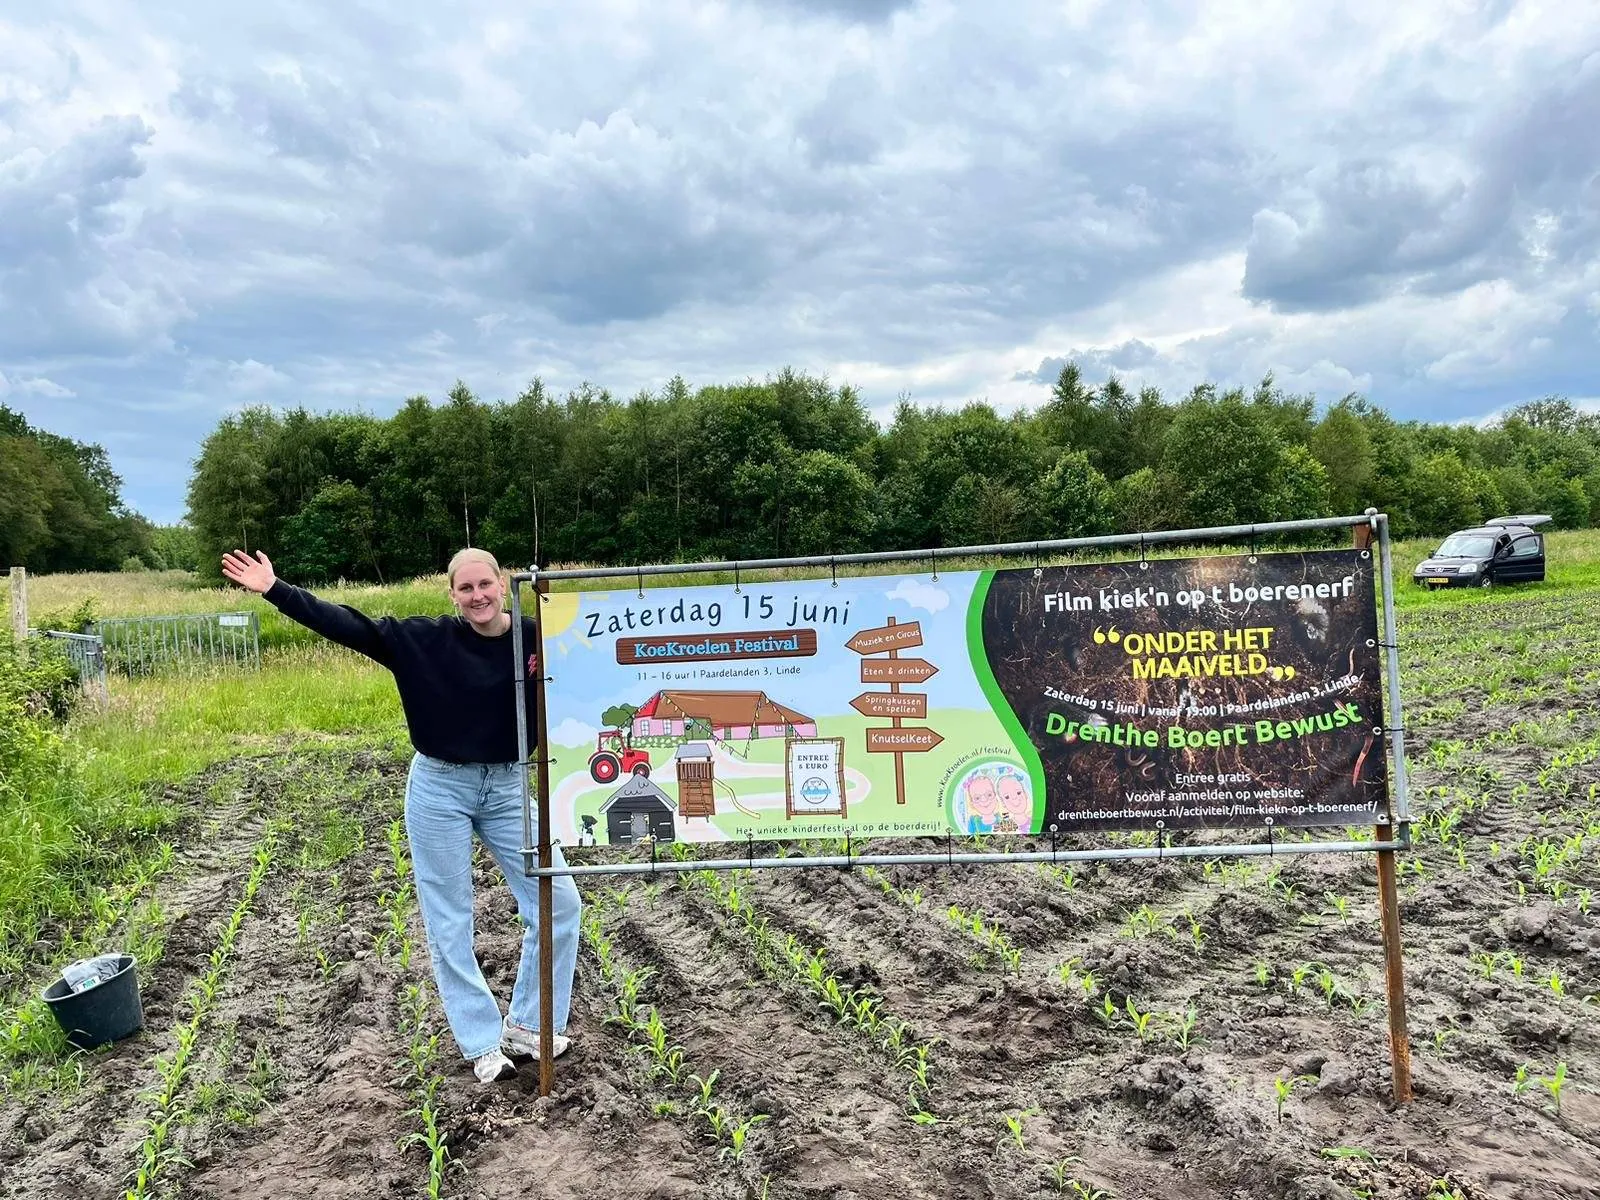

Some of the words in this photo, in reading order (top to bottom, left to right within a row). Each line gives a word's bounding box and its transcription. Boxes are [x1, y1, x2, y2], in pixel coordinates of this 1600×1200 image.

[1043, 592, 1093, 613] Film
[1099, 587, 1170, 611] kiek'n
[1175, 590, 1206, 609] op
[1229, 576, 1354, 603] boerenerf
[585, 598, 722, 638] Zaterdag
[742, 594, 773, 620] 15
[786, 595, 851, 627] juni
[633, 639, 731, 659] KoeKroelen
[734, 635, 799, 653] Festival
[855, 636, 884, 649] Muziek
[885, 634, 895, 642] en
[896, 630, 920, 639] Circus
[1223, 627, 1274, 651] HET
[637, 672, 647, 681] 11
[661, 671, 672, 680] 16
[674, 672, 690, 680] uur
[700, 667, 760, 679] Paardelanden
[776, 665, 801, 675] Linde
[863, 667, 884, 675] Eten
[887, 666, 893, 675] &
[898, 666, 931, 675] drinken
[865, 695, 921, 706] Springkussen
[1043, 685, 1097, 710] Zaterdag
[1100, 700, 1114, 711] 15
[1114, 701, 1139, 714] juni
[1148, 704, 1182, 717] vanaf
[1185, 705, 1217, 717] 19:00
[1226, 691, 1311, 714] Paardelanden
[1310, 686, 1325, 697] 3,
[1324, 674, 1359, 693] Linde
[886, 705, 917, 713] spellen
[1045, 712, 1159, 748] Drenthe
[1168, 725, 1249, 749] Boert
[1254, 701, 1363, 743] Bewust
[871, 733, 932, 744] KnutselKeet
[1175, 773, 1215, 784] Entree
[1217, 773, 1251, 785] gratis
[1125, 790, 1166, 803] Vooraf
[1169, 789, 1233, 801] aanmelden
[1235, 790, 1251, 800] op
[1254, 787, 1304, 799] website:
[757, 825, 789, 834] unieke
[862, 824, 874, 834] op
[878, 822, 889, 831] de
